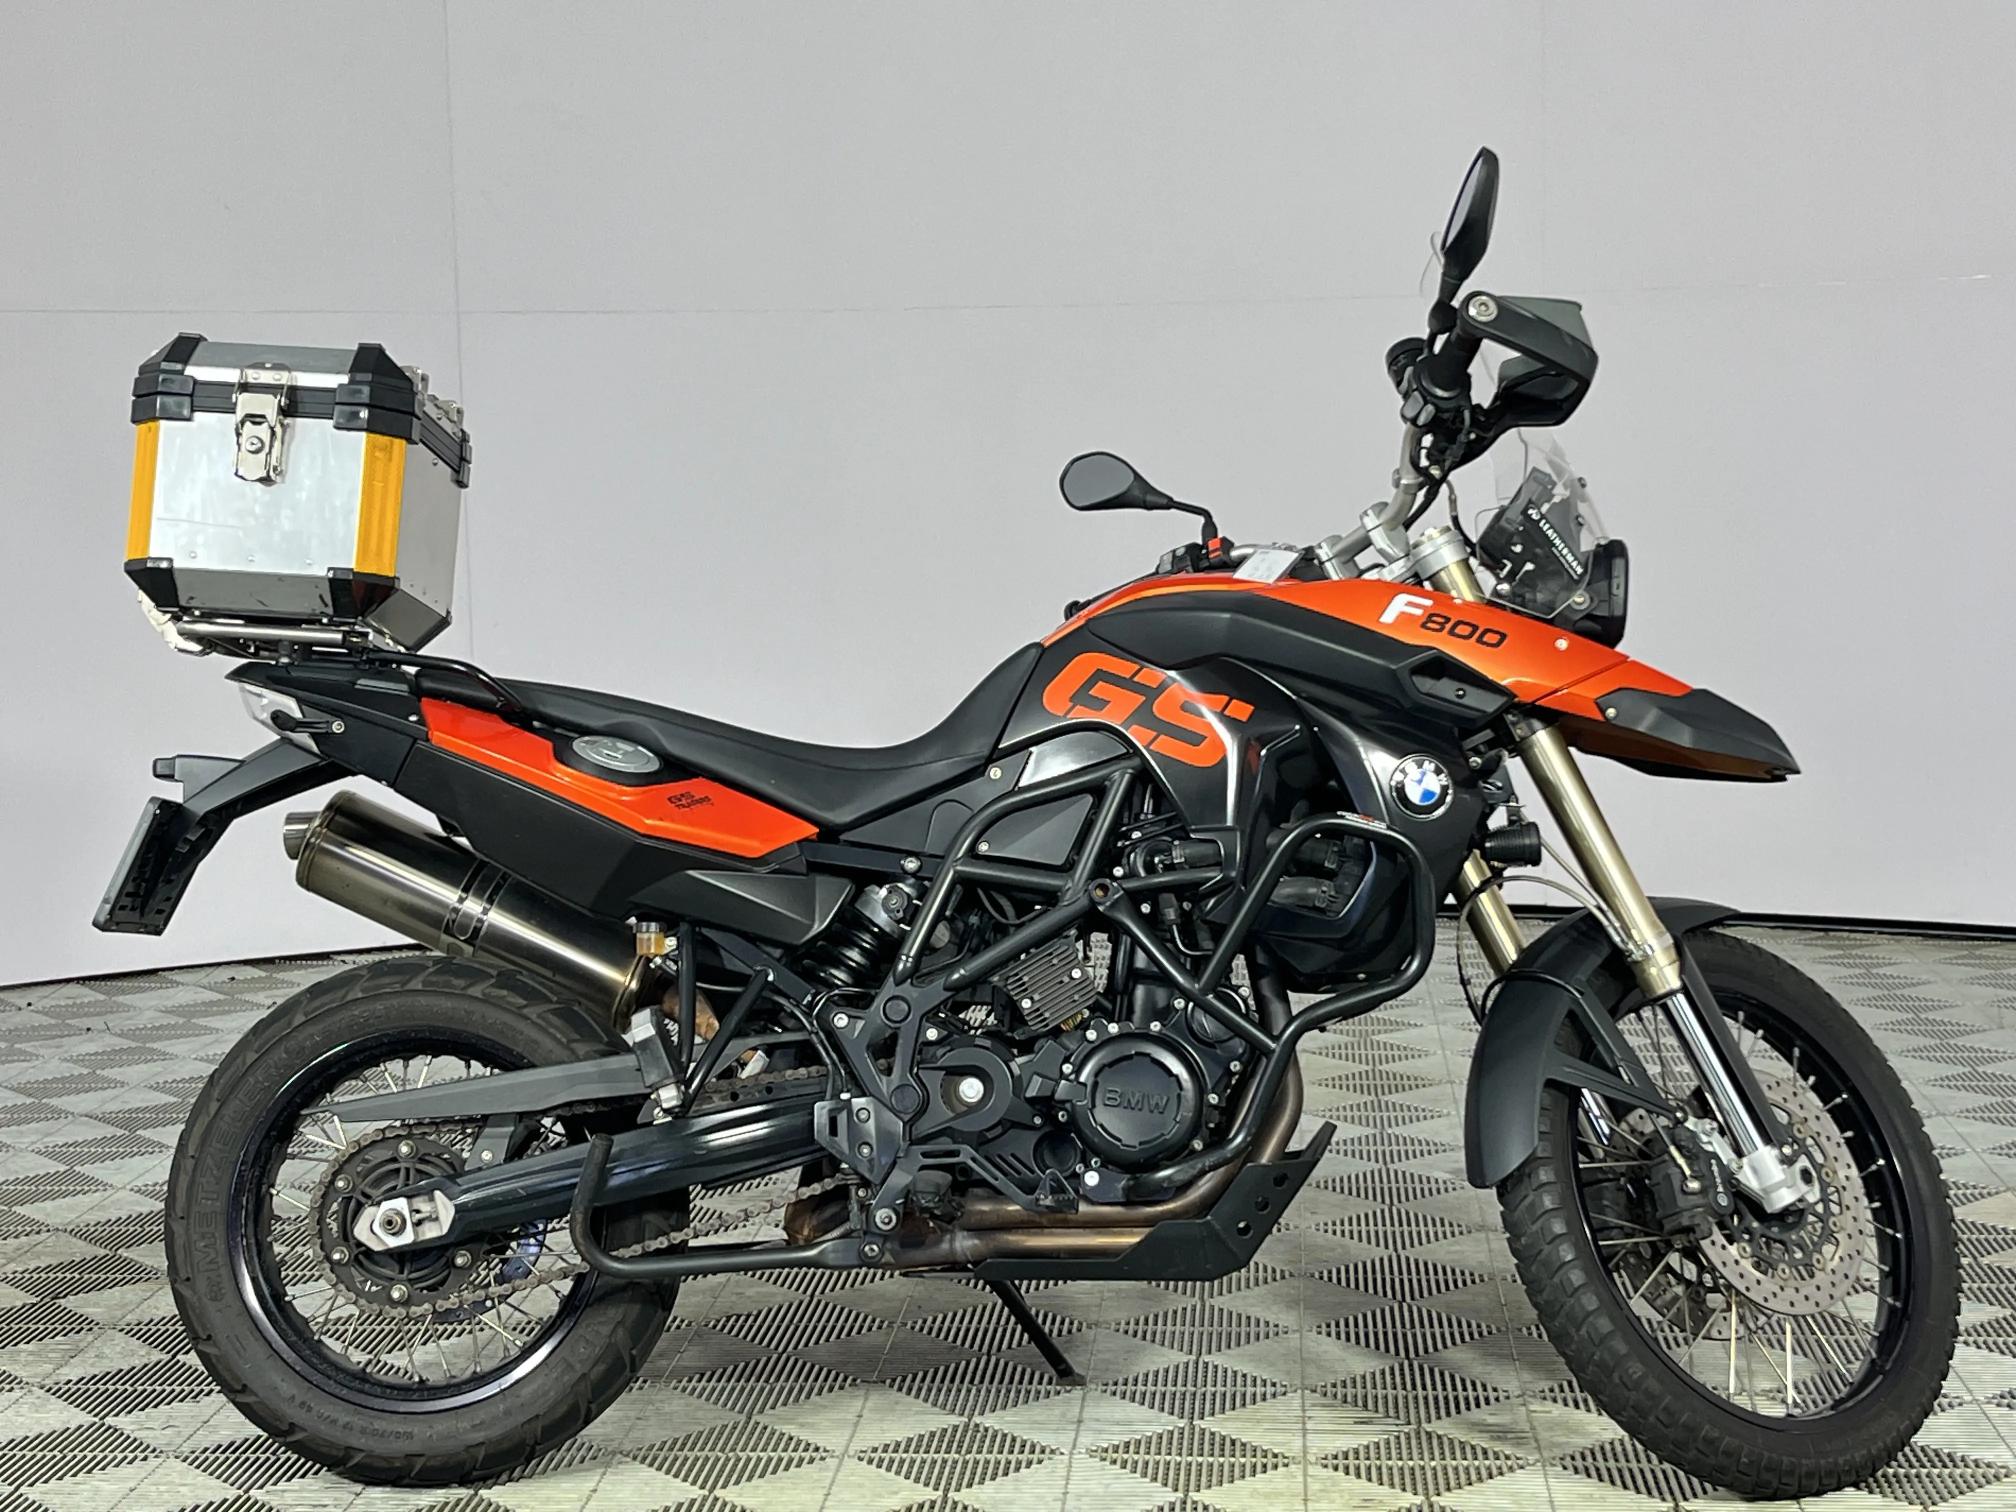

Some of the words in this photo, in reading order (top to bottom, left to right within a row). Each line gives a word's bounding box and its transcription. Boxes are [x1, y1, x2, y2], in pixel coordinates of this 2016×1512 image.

[1539, 519, 1584, 575] LEATHERMAN
[1379, 593, 1433, 624] F
[1420, 613, 1508, 648] 800
[1042, 652, 1255, 768] GS
[1392, 760, 1449, 786] BMW
[1103, 1087, 1170, 1115] BMW
